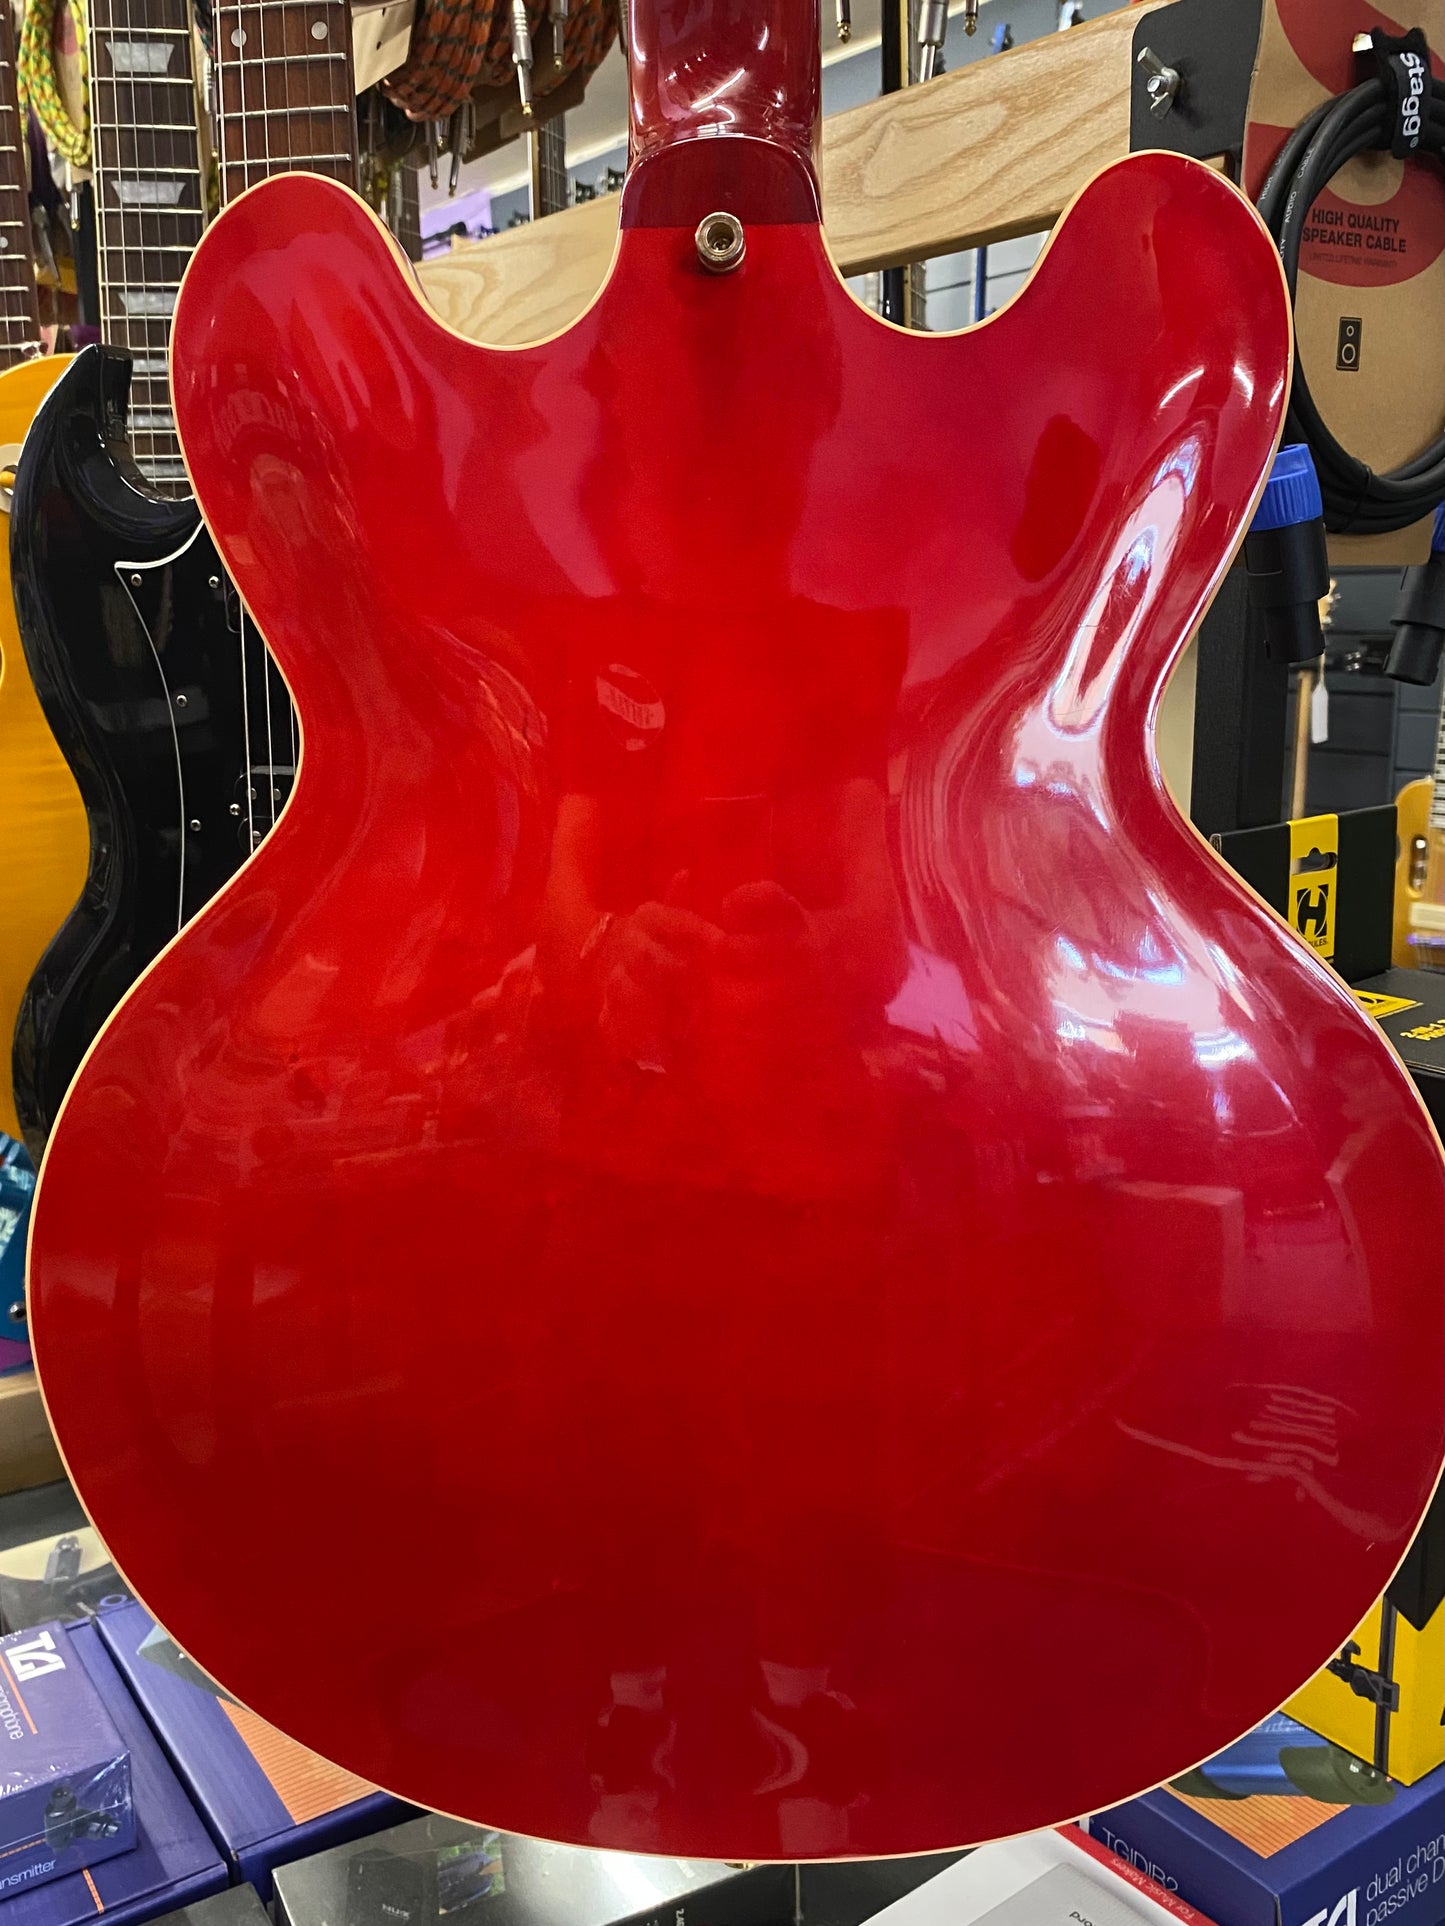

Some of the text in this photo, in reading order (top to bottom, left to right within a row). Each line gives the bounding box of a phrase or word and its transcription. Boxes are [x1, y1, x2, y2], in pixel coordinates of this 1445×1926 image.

[1284, 191, 1297, 223] AUDIO
[1312, 208, 1400, 233] HIGH QUALITY
[1302, 227, 1407, 253] SPEAKER CABLE
[1111, 1858, 1195, 1920] For Music Makers
[1366, 1857, 1402, 1901] dual
[1366, 1873, 1428, 1926] passive
